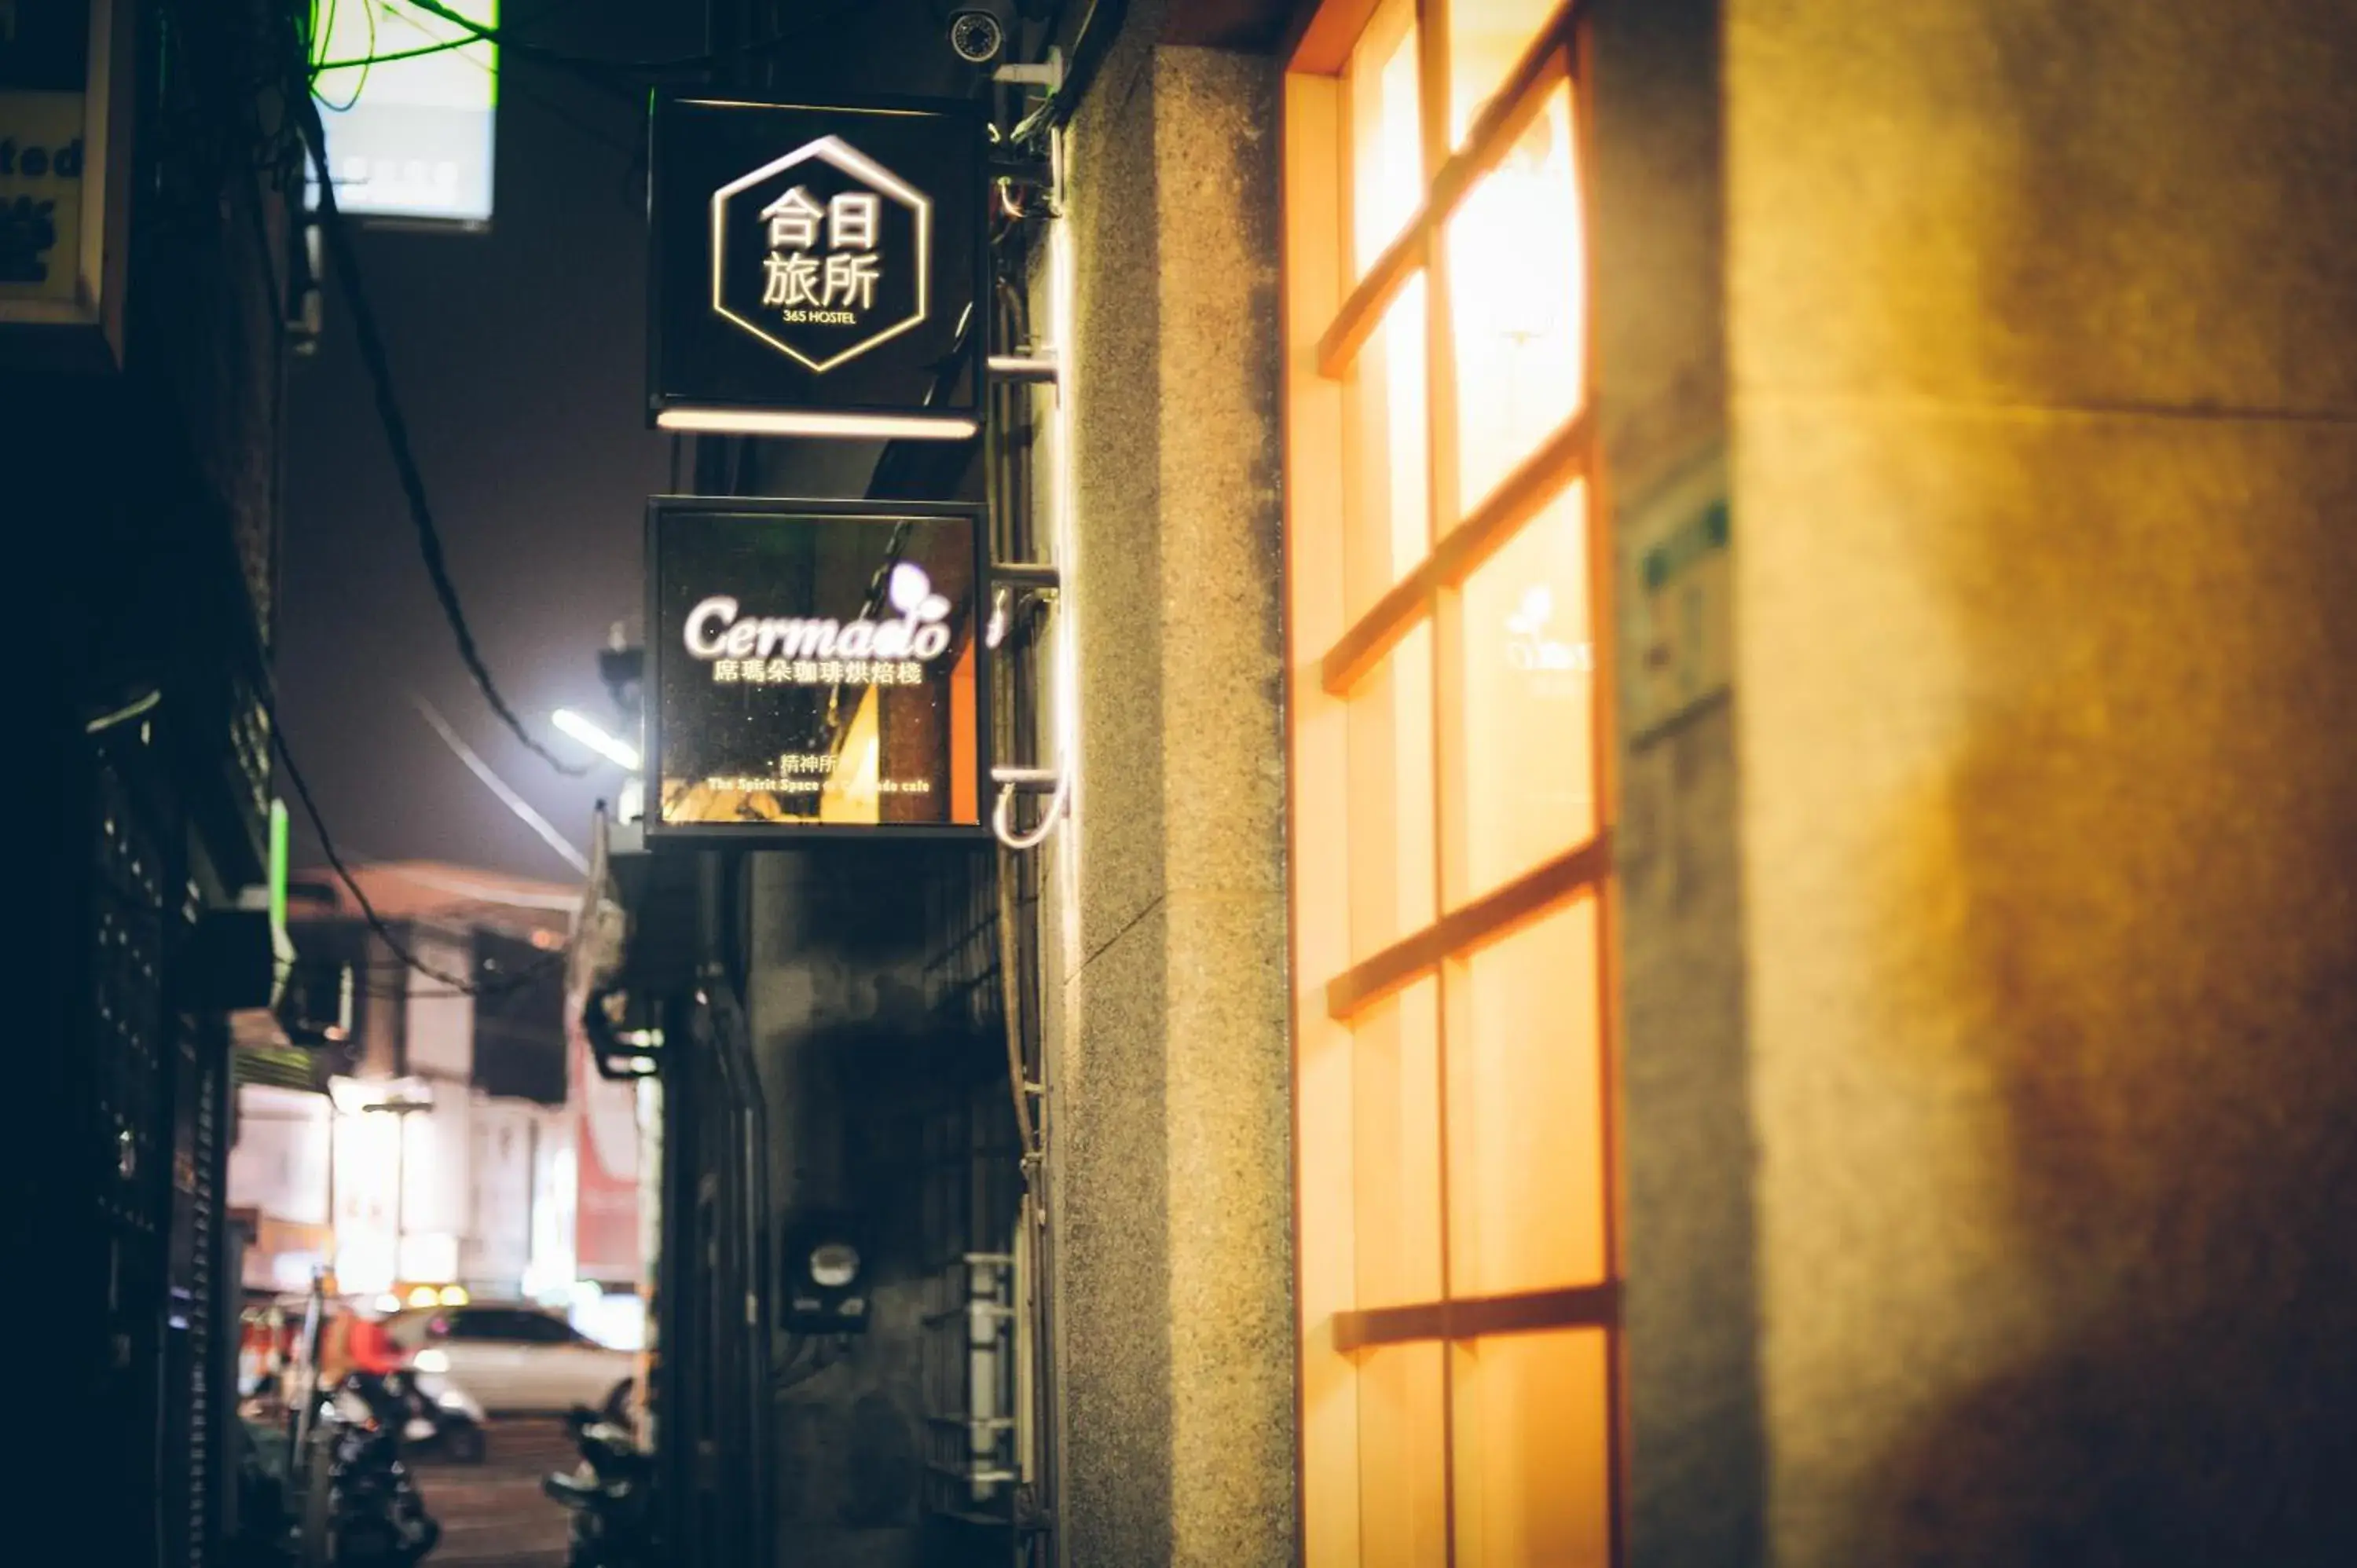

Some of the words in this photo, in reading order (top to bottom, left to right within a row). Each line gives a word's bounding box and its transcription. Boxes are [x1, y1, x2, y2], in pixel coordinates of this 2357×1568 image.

[759, 185, 881, 250] 合日
[761, 251, 880, 310] 旅所
[783, 309, 806, 323] 365
[808, 310, 856, 324] HOSTEL
[683, 593, 951, 661] Cermado
[708, 777, 733, 790] The
[737, 778, 776, 793] Spirit
[780, 778, 819, 793] Space
[901, 779, 930, 793] cafe
